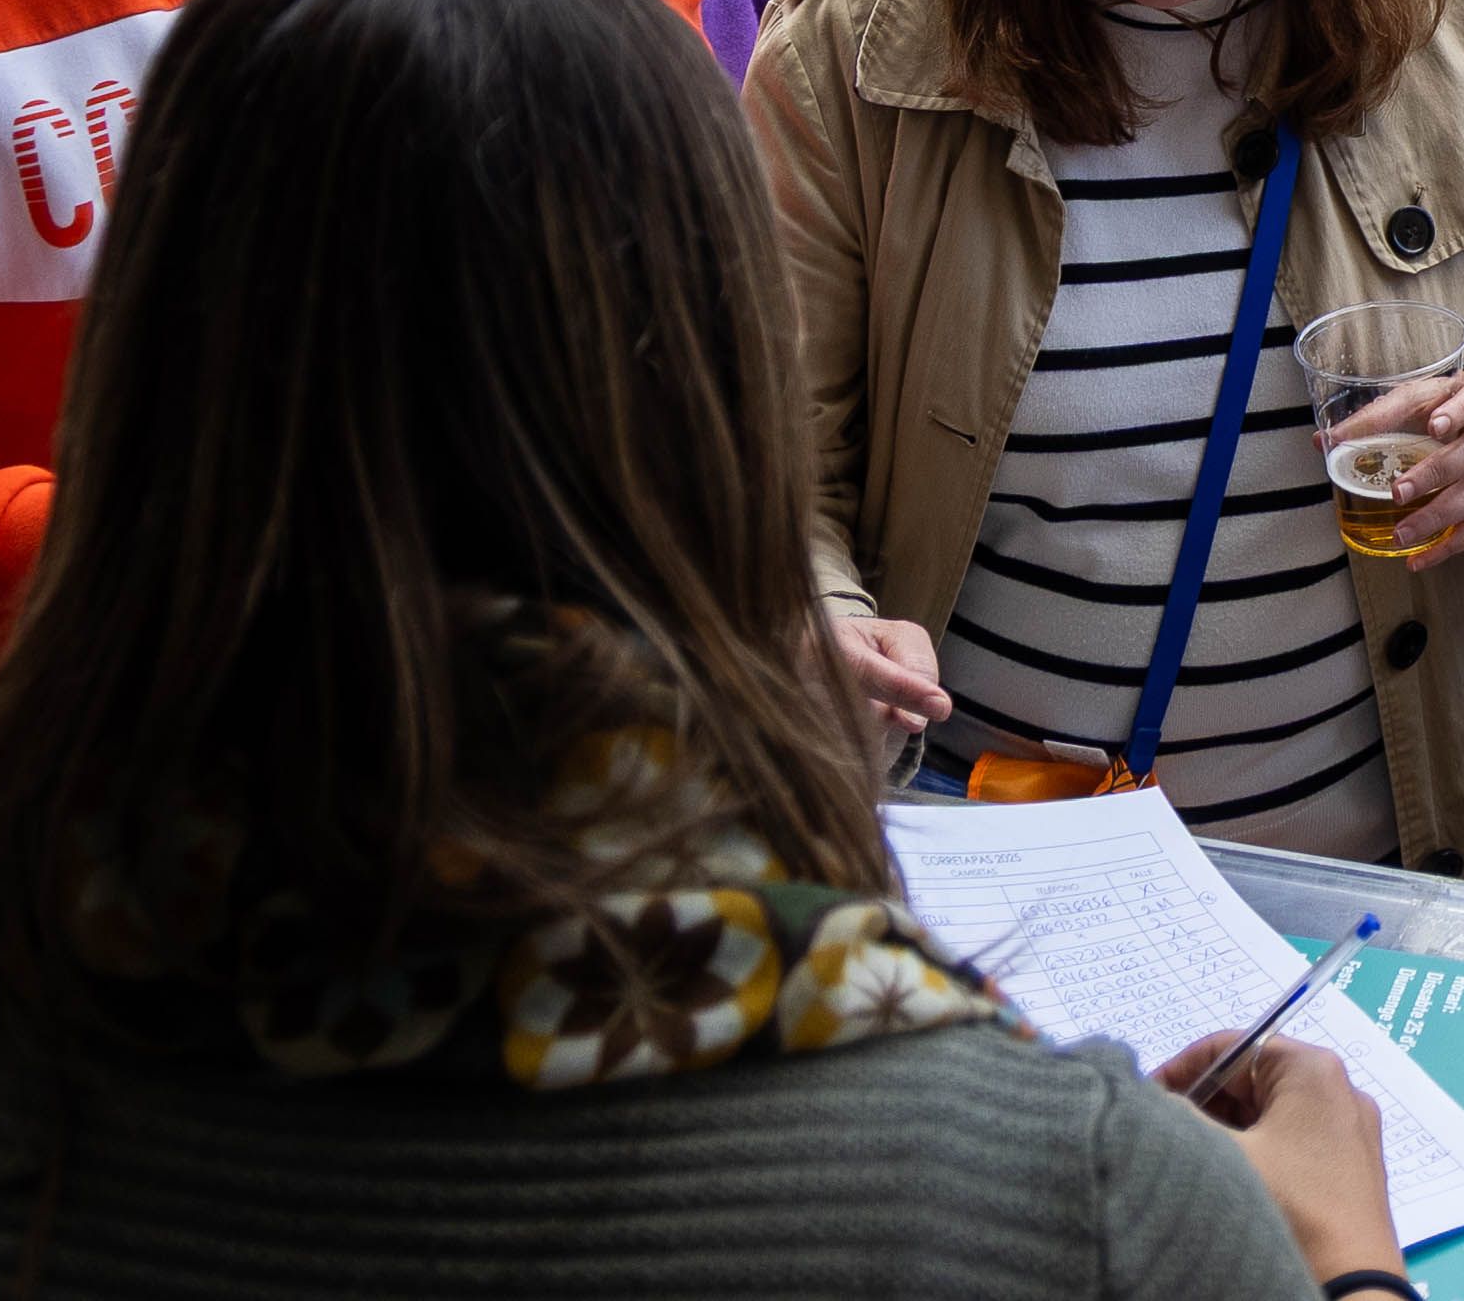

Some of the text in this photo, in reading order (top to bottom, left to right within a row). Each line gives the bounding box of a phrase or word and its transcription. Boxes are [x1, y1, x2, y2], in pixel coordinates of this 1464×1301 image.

[1376, 965, 1418, 1022] Diumenge
[1410, 970, 1446, 1020] Dissabte
[1402, 1018, 1426, 1036] 25
